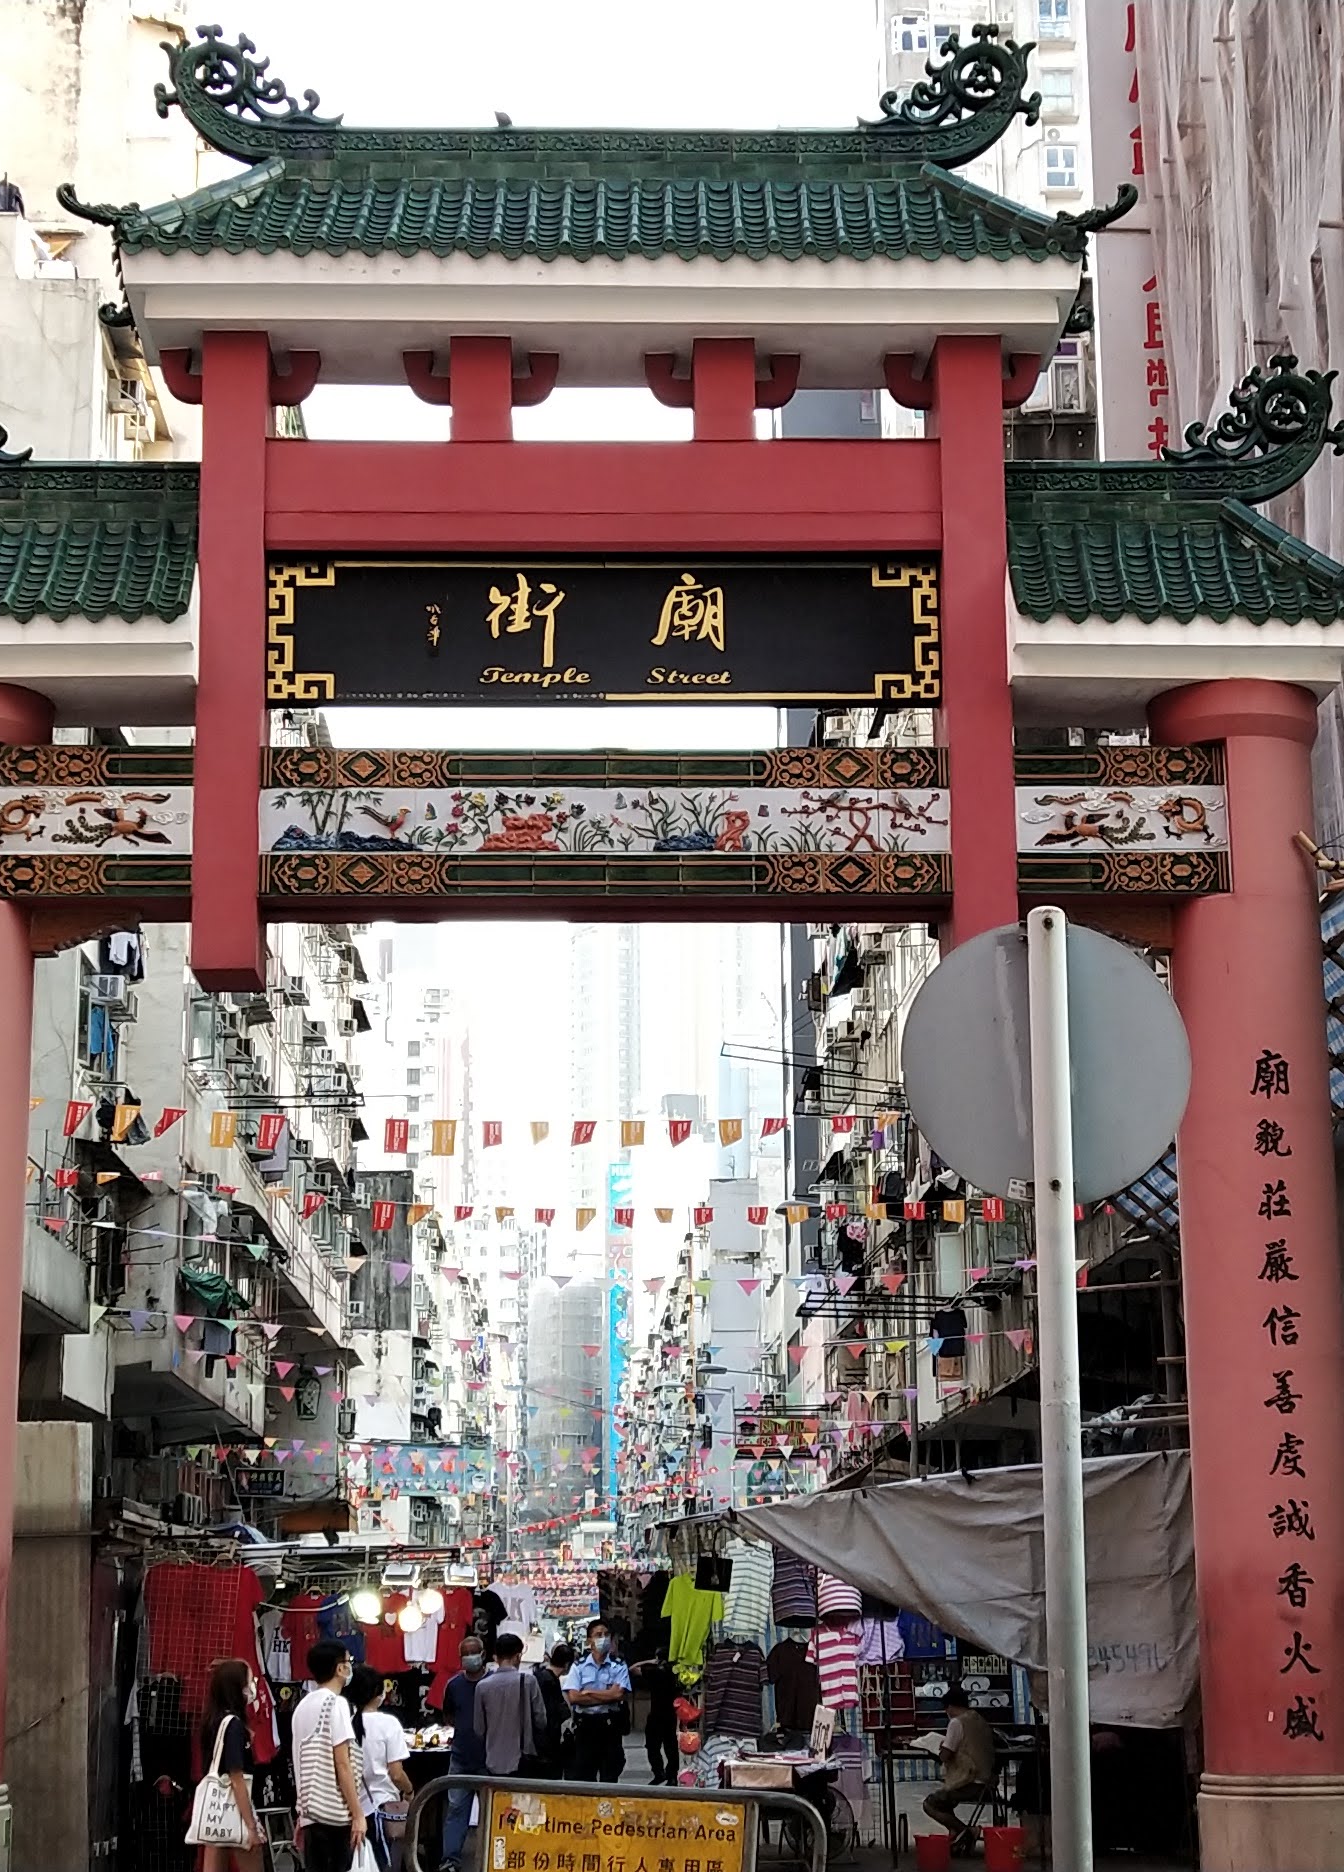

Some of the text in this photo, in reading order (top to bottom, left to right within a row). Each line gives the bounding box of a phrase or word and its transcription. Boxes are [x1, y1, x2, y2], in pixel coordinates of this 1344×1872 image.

[479, 667, 732, 688] Temple Street
[205, 1826, 233, 1838] BABY
[591, 1819, 688, 1841] Pedestrian
[695, 1824, 736, 1843] Area
